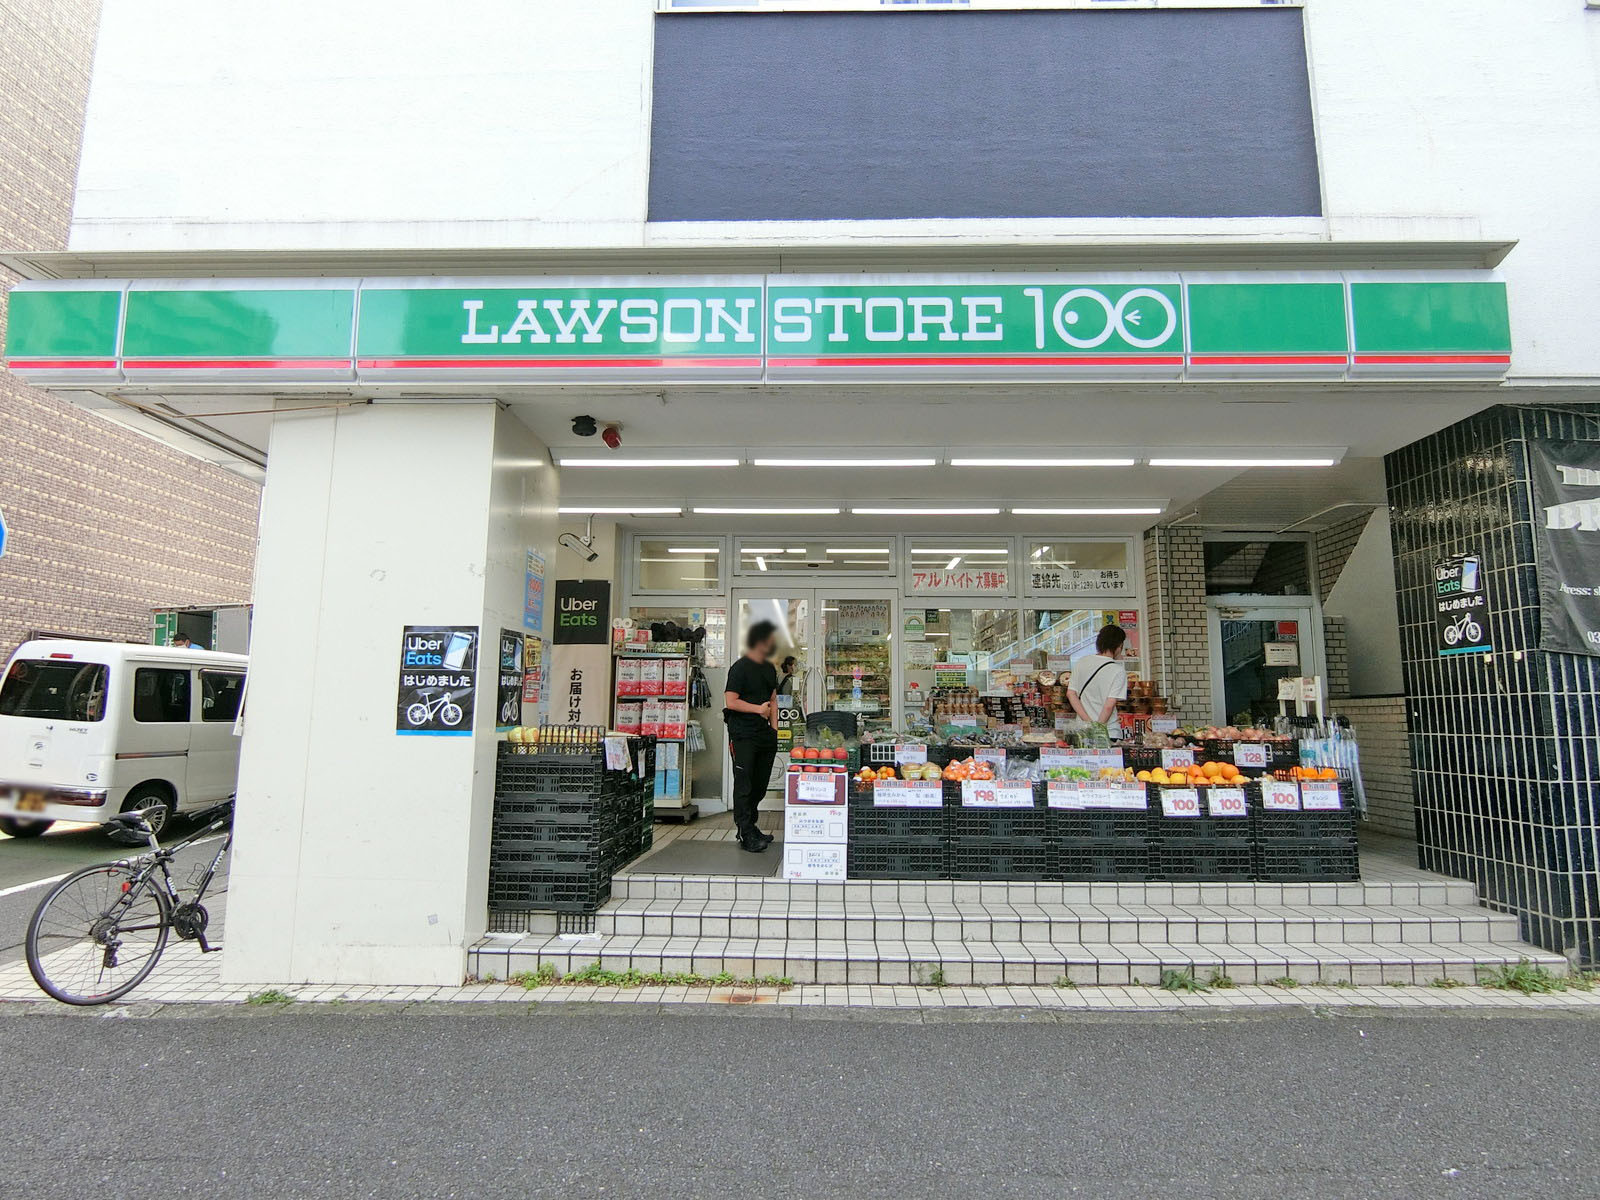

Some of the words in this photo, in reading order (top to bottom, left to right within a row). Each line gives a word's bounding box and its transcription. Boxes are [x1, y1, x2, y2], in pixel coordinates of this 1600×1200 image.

[461, 297, 756, 345] LAWSON
[773, 295, 1004, 343] STORE
[1023, 286, 1177, 350] 100
[1100, 570, 1119, 579] お待ち
[1436, 567, 1459, 580] Uber
[1032, 572, 1061, 589] 連絡先
[1095, 581, 1125, 589] しています
[1437, 580, 1461, 594] Eats
[560, 597, 598, 611] Uber
[1438, 595, 1484, 612] はじめました
[560, 613, 598, 627] Eats
[408, 637, 443, 650] Uber
[406, 651, 442, 665] Eats
[403, 674, 472, 687] はじめました
[1171, 758, 1190, 767] 100
[1243, 753, 1262, 763] 128
[974, 790, 995, 802] 198
[1272, 792, 1296, 805] 100
[1172, 799, 1195, 810] 100
[1219, 799, 1242, 810] 100
